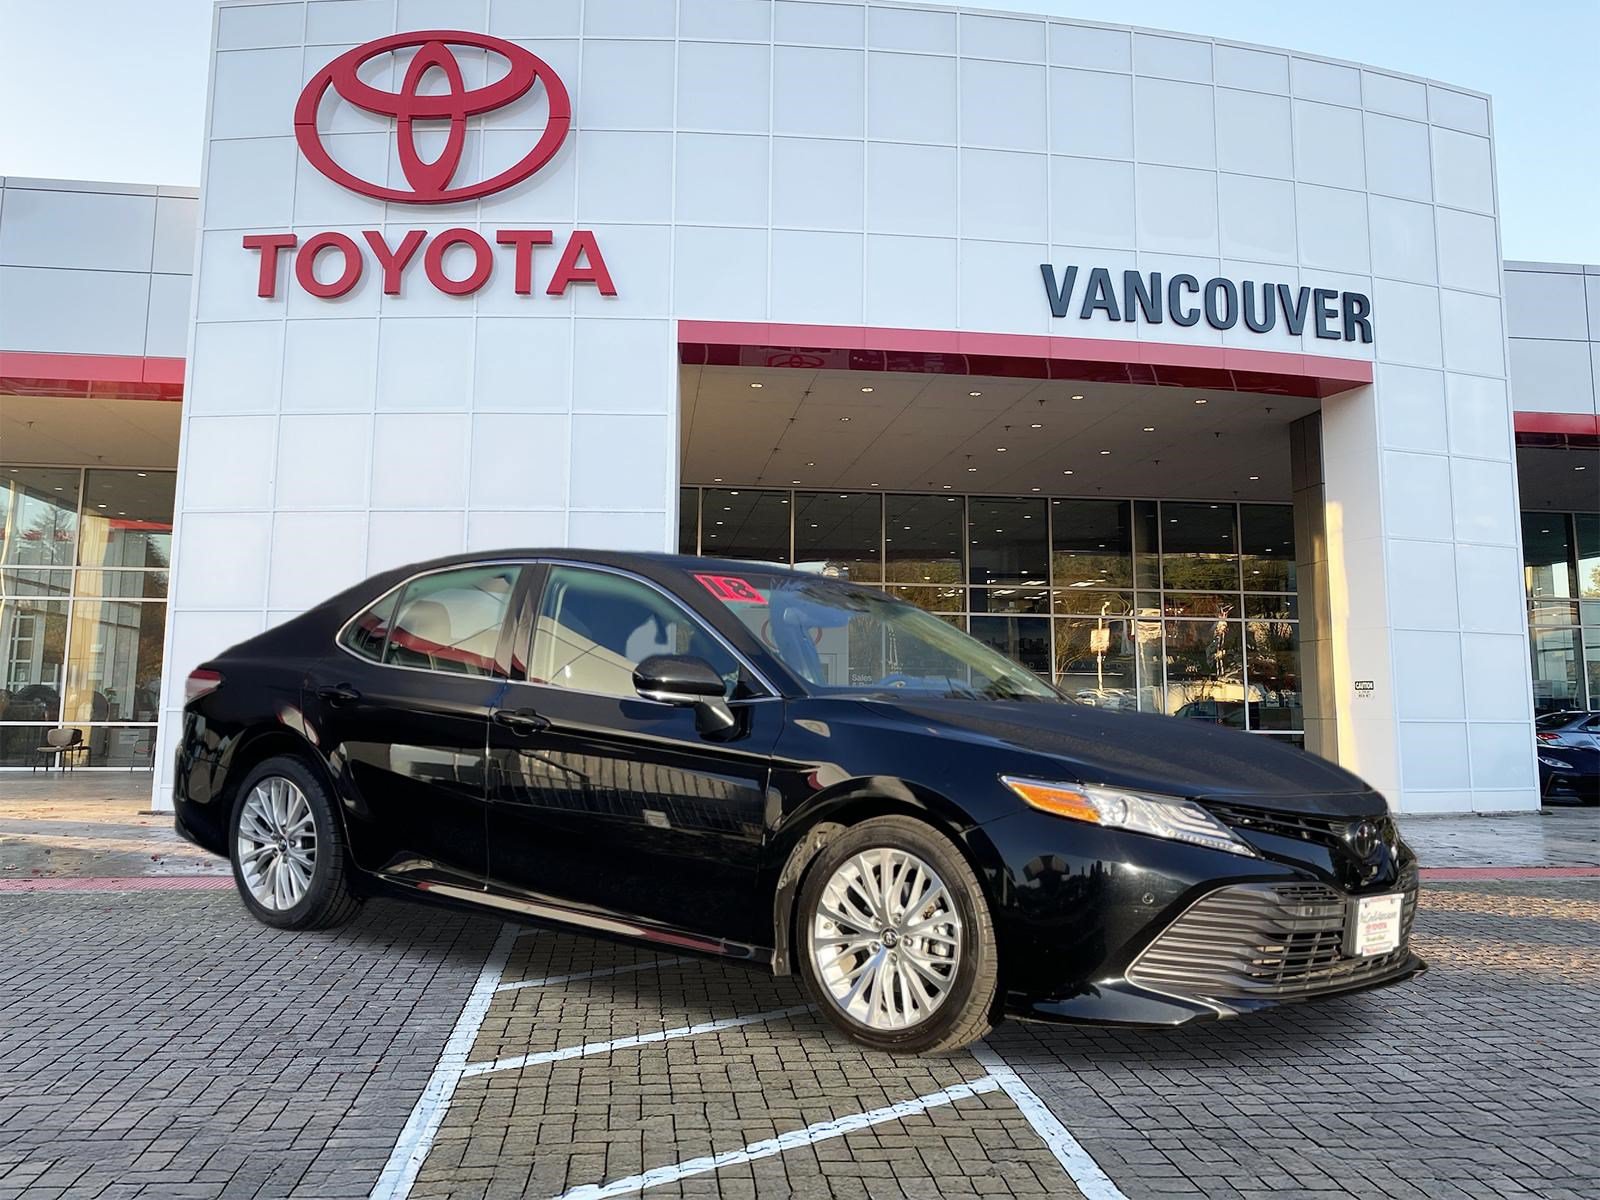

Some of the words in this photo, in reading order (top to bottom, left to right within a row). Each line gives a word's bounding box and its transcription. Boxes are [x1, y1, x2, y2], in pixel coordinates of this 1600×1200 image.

[243, 228, 618, 299] TOYOTA
[1040, 263, 1374, 344] VANCOUVER
[701, 576, 757, 599] 18
[851, 673, 873, 682] Sales
